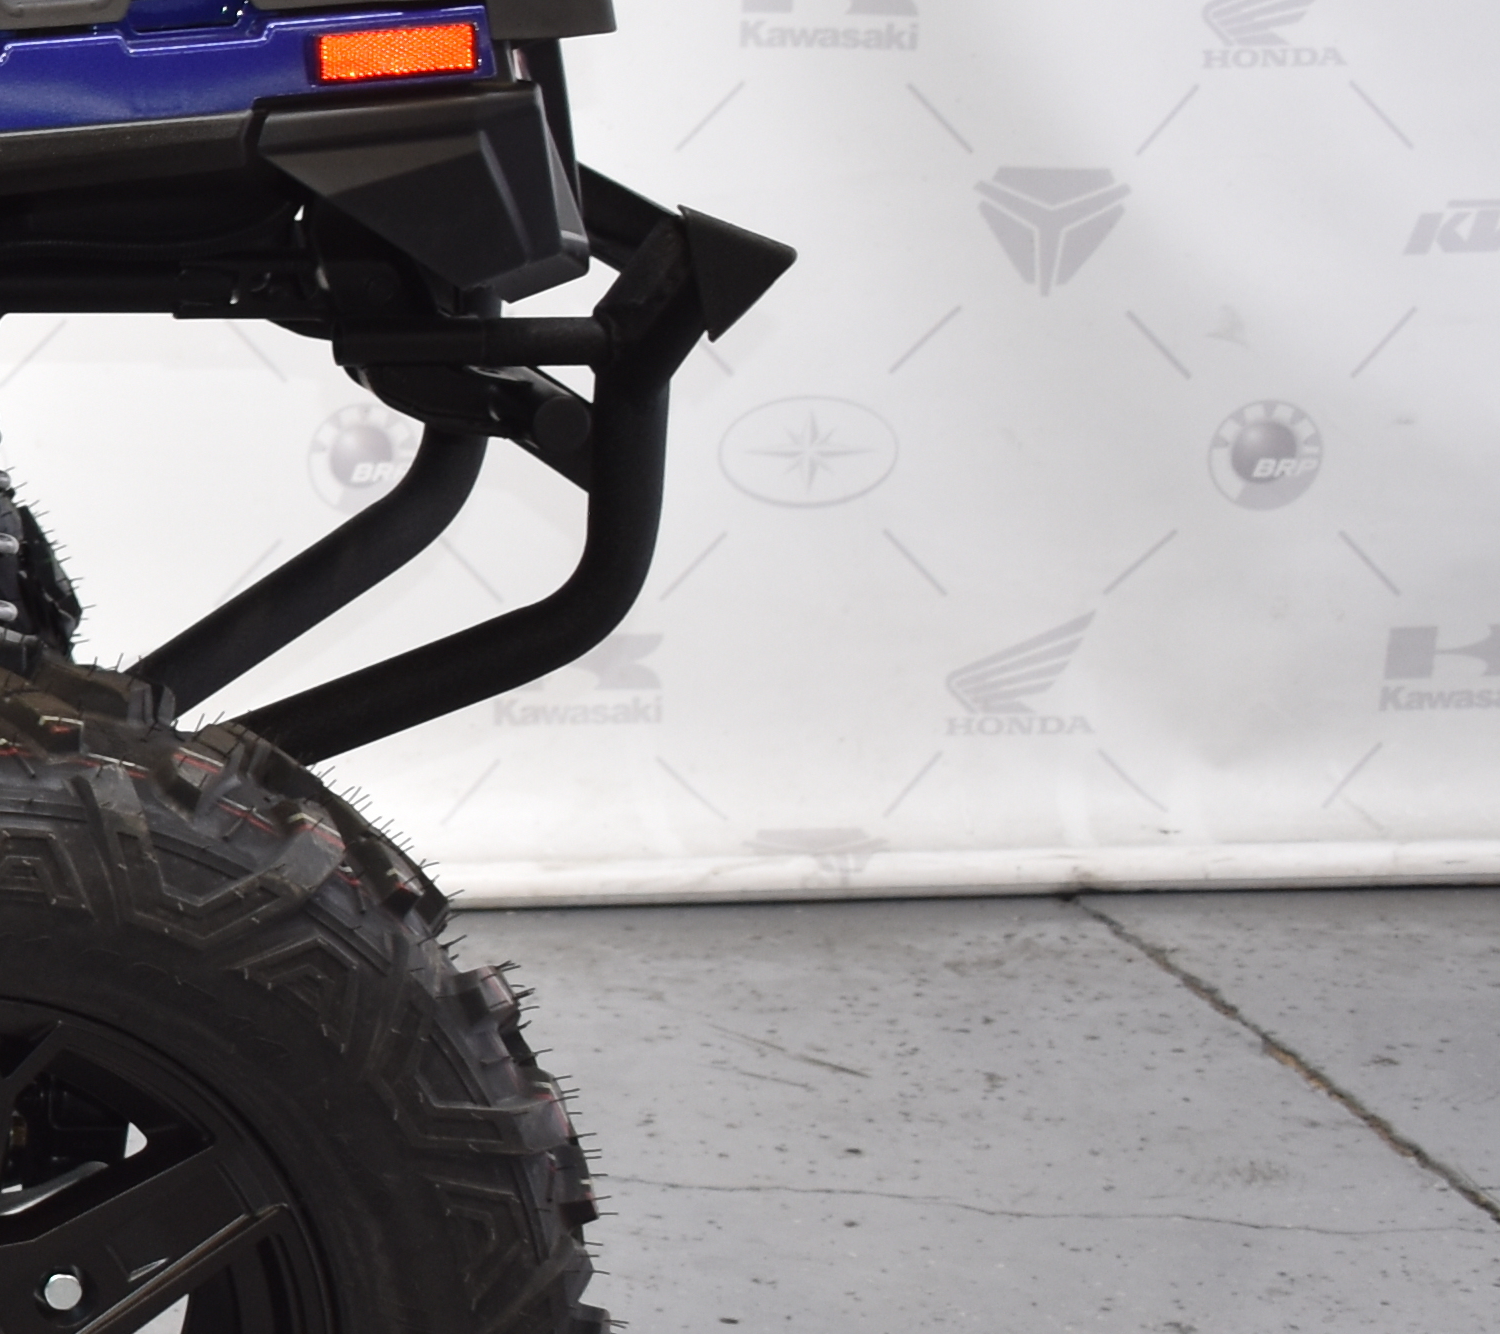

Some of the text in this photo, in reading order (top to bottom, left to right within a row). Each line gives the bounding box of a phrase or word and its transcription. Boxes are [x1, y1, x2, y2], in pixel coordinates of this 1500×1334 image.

[740, 19, 920, 50] Kawasaki
[1202, 47, 1345, 69] HONDA
[1252, 457, 1318, 479] BRP
[492, 692, 663, 725] Kawasaki
[945, 717, 1092, 737] HONDA
